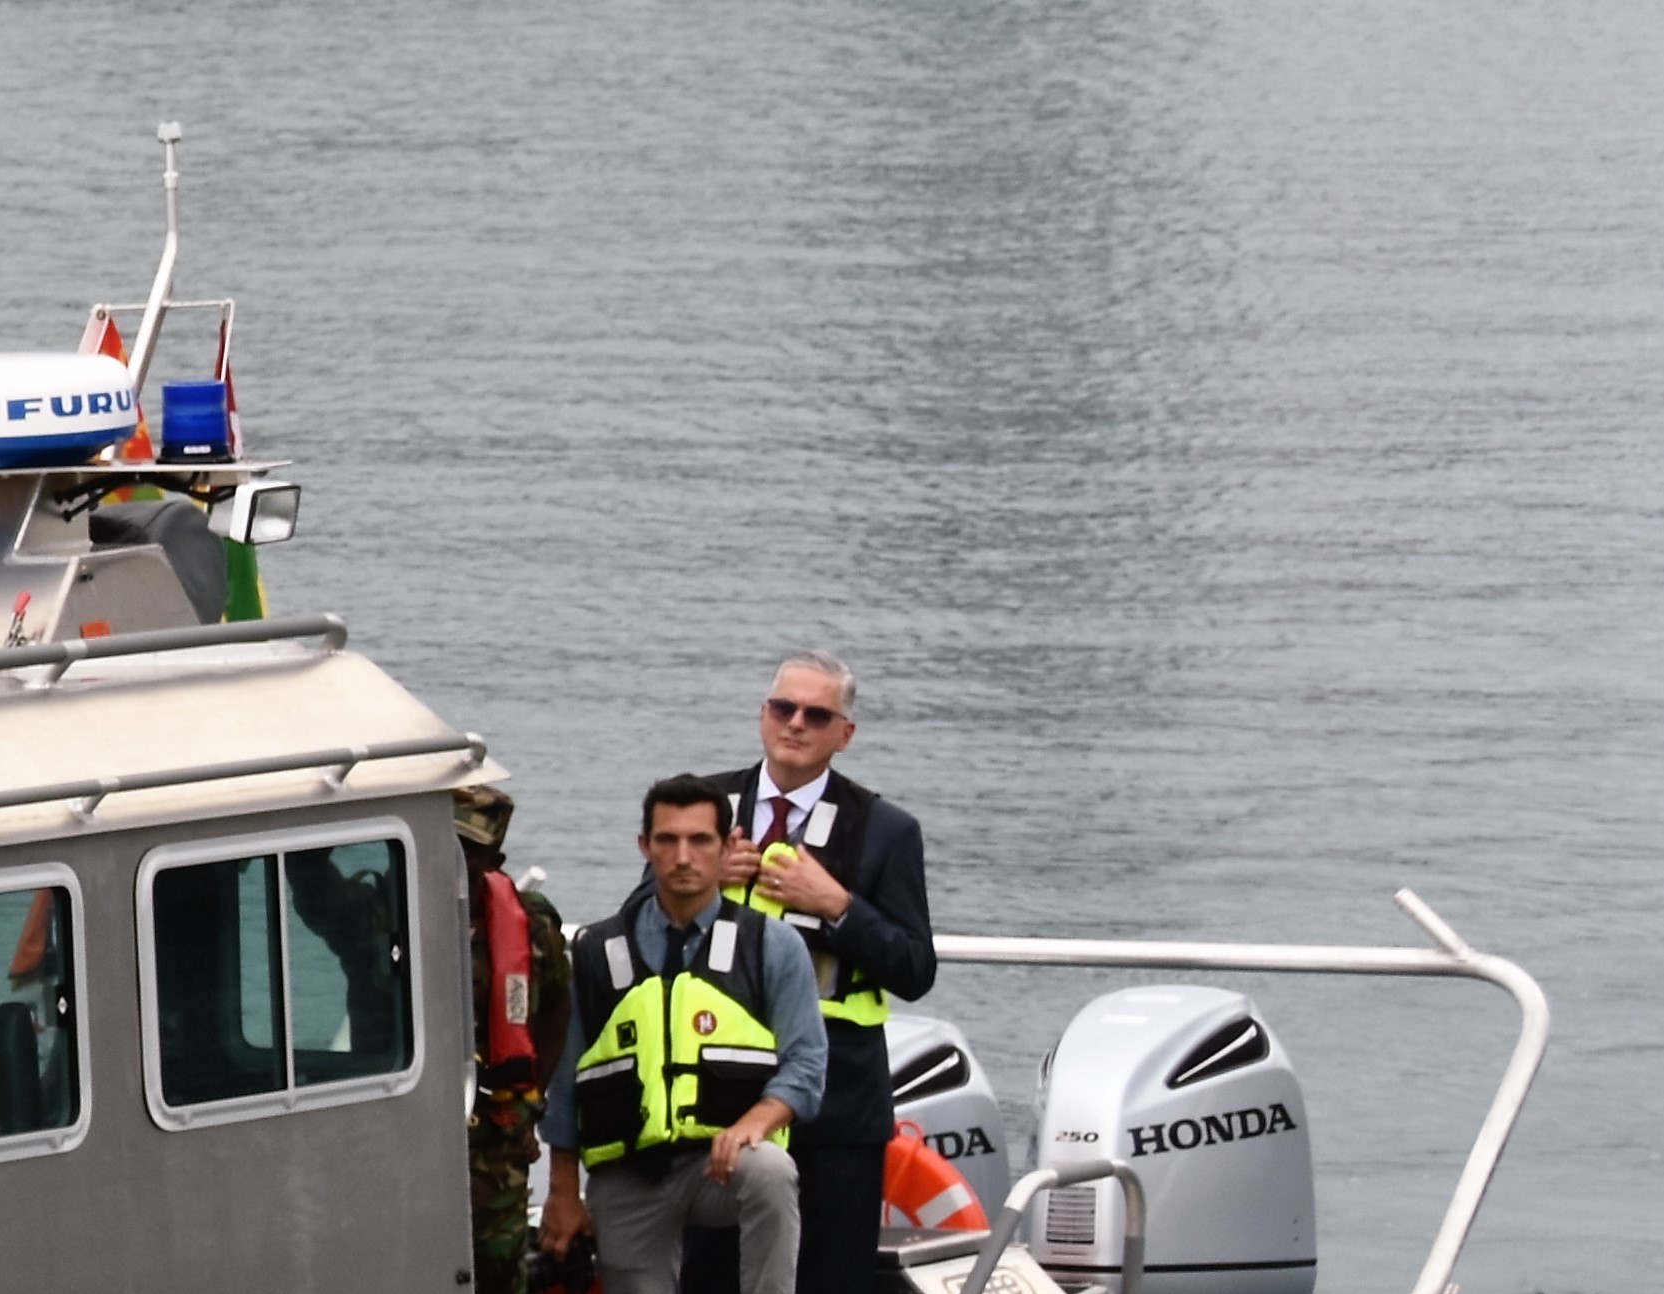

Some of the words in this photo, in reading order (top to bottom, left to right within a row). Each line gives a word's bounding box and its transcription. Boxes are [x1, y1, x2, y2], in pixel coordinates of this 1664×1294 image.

[7, 387, 136, 421] FURU
[1055, 1131, 1100, 1143] 250
[1127, 1103, 1297, 1157] HONDA
